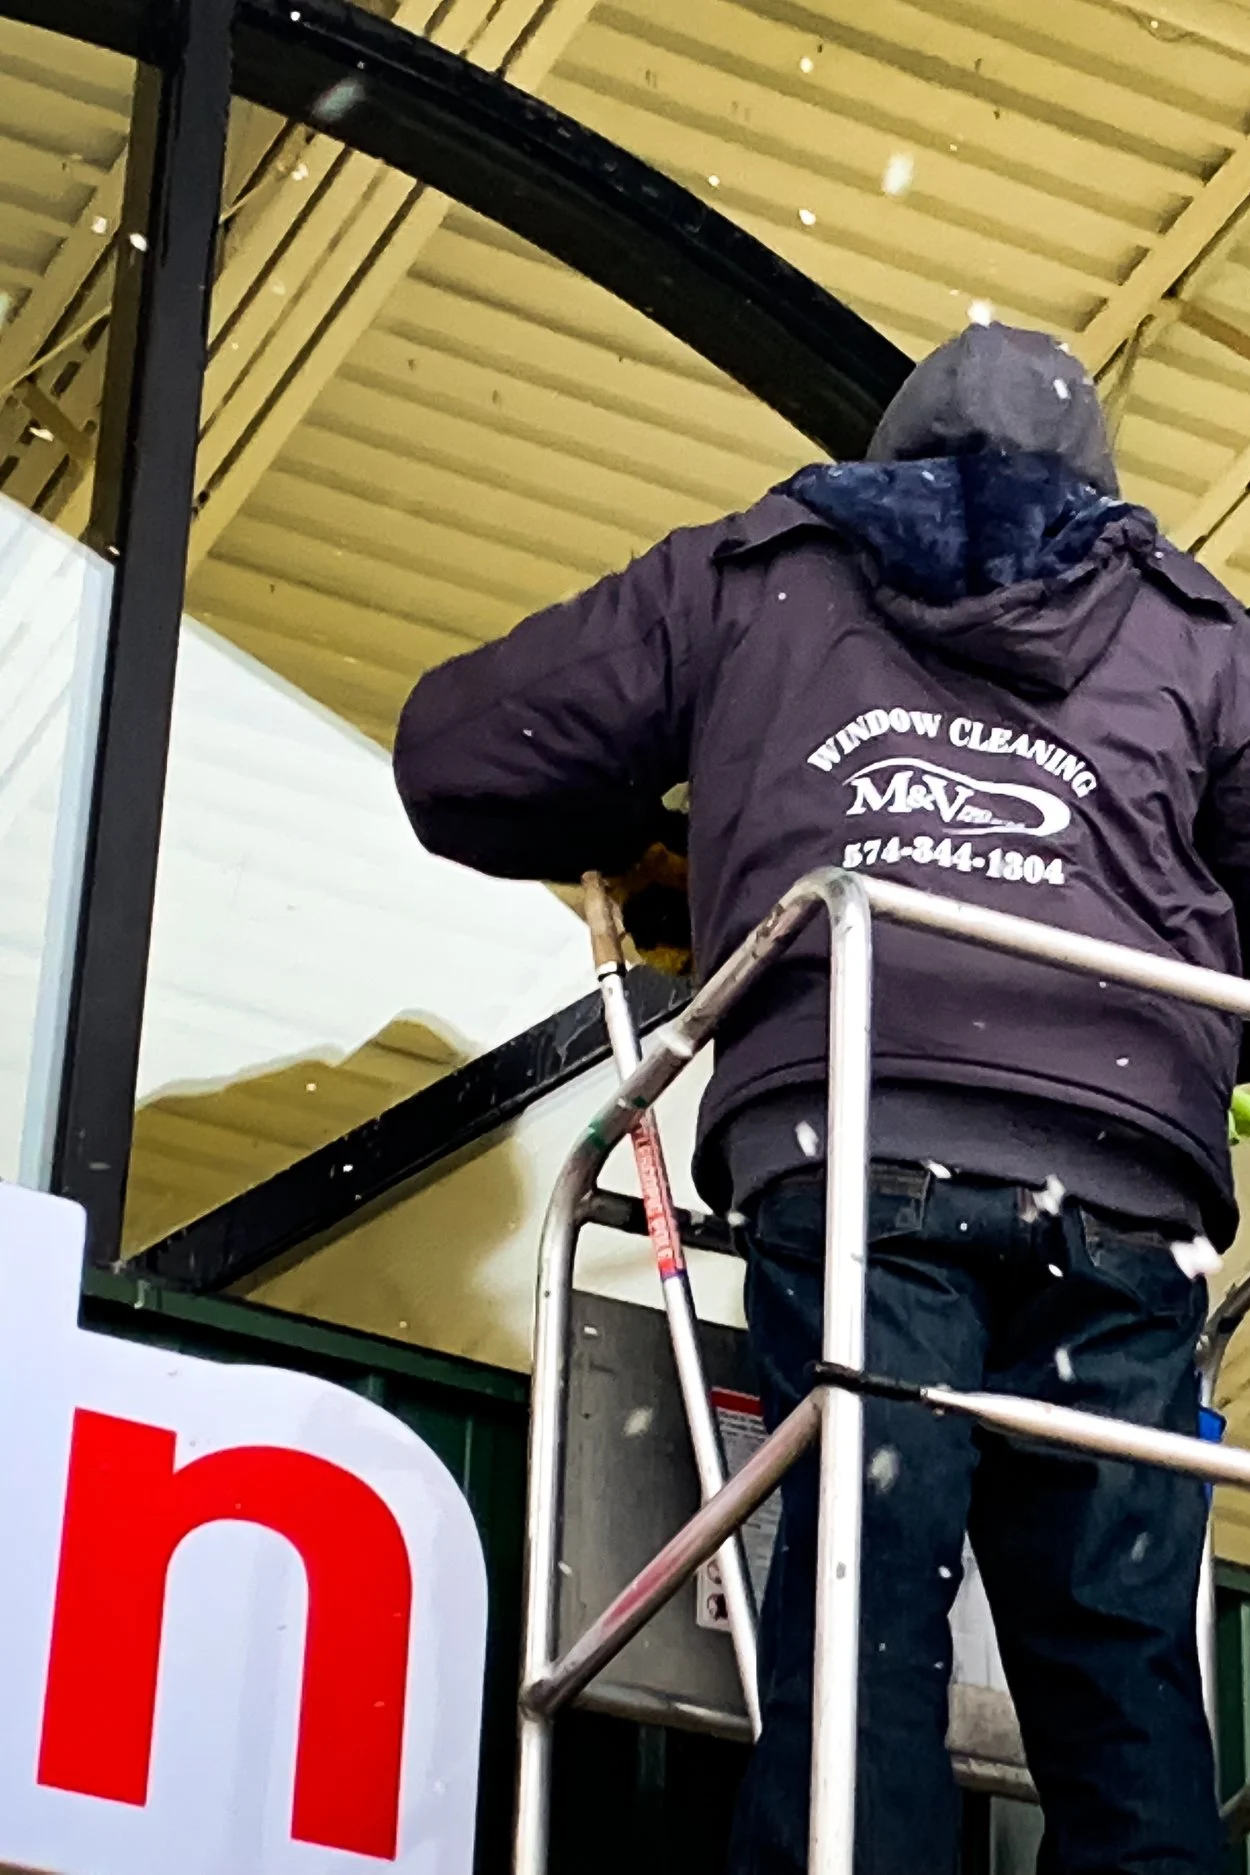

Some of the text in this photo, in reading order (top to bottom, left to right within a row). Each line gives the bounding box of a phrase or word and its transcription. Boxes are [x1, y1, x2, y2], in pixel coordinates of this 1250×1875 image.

[807, 708, 1098, 798] WINDOW CLEANING
[846, 770, 974, 823] M&V
[38, 1407, 412, 1860] n
